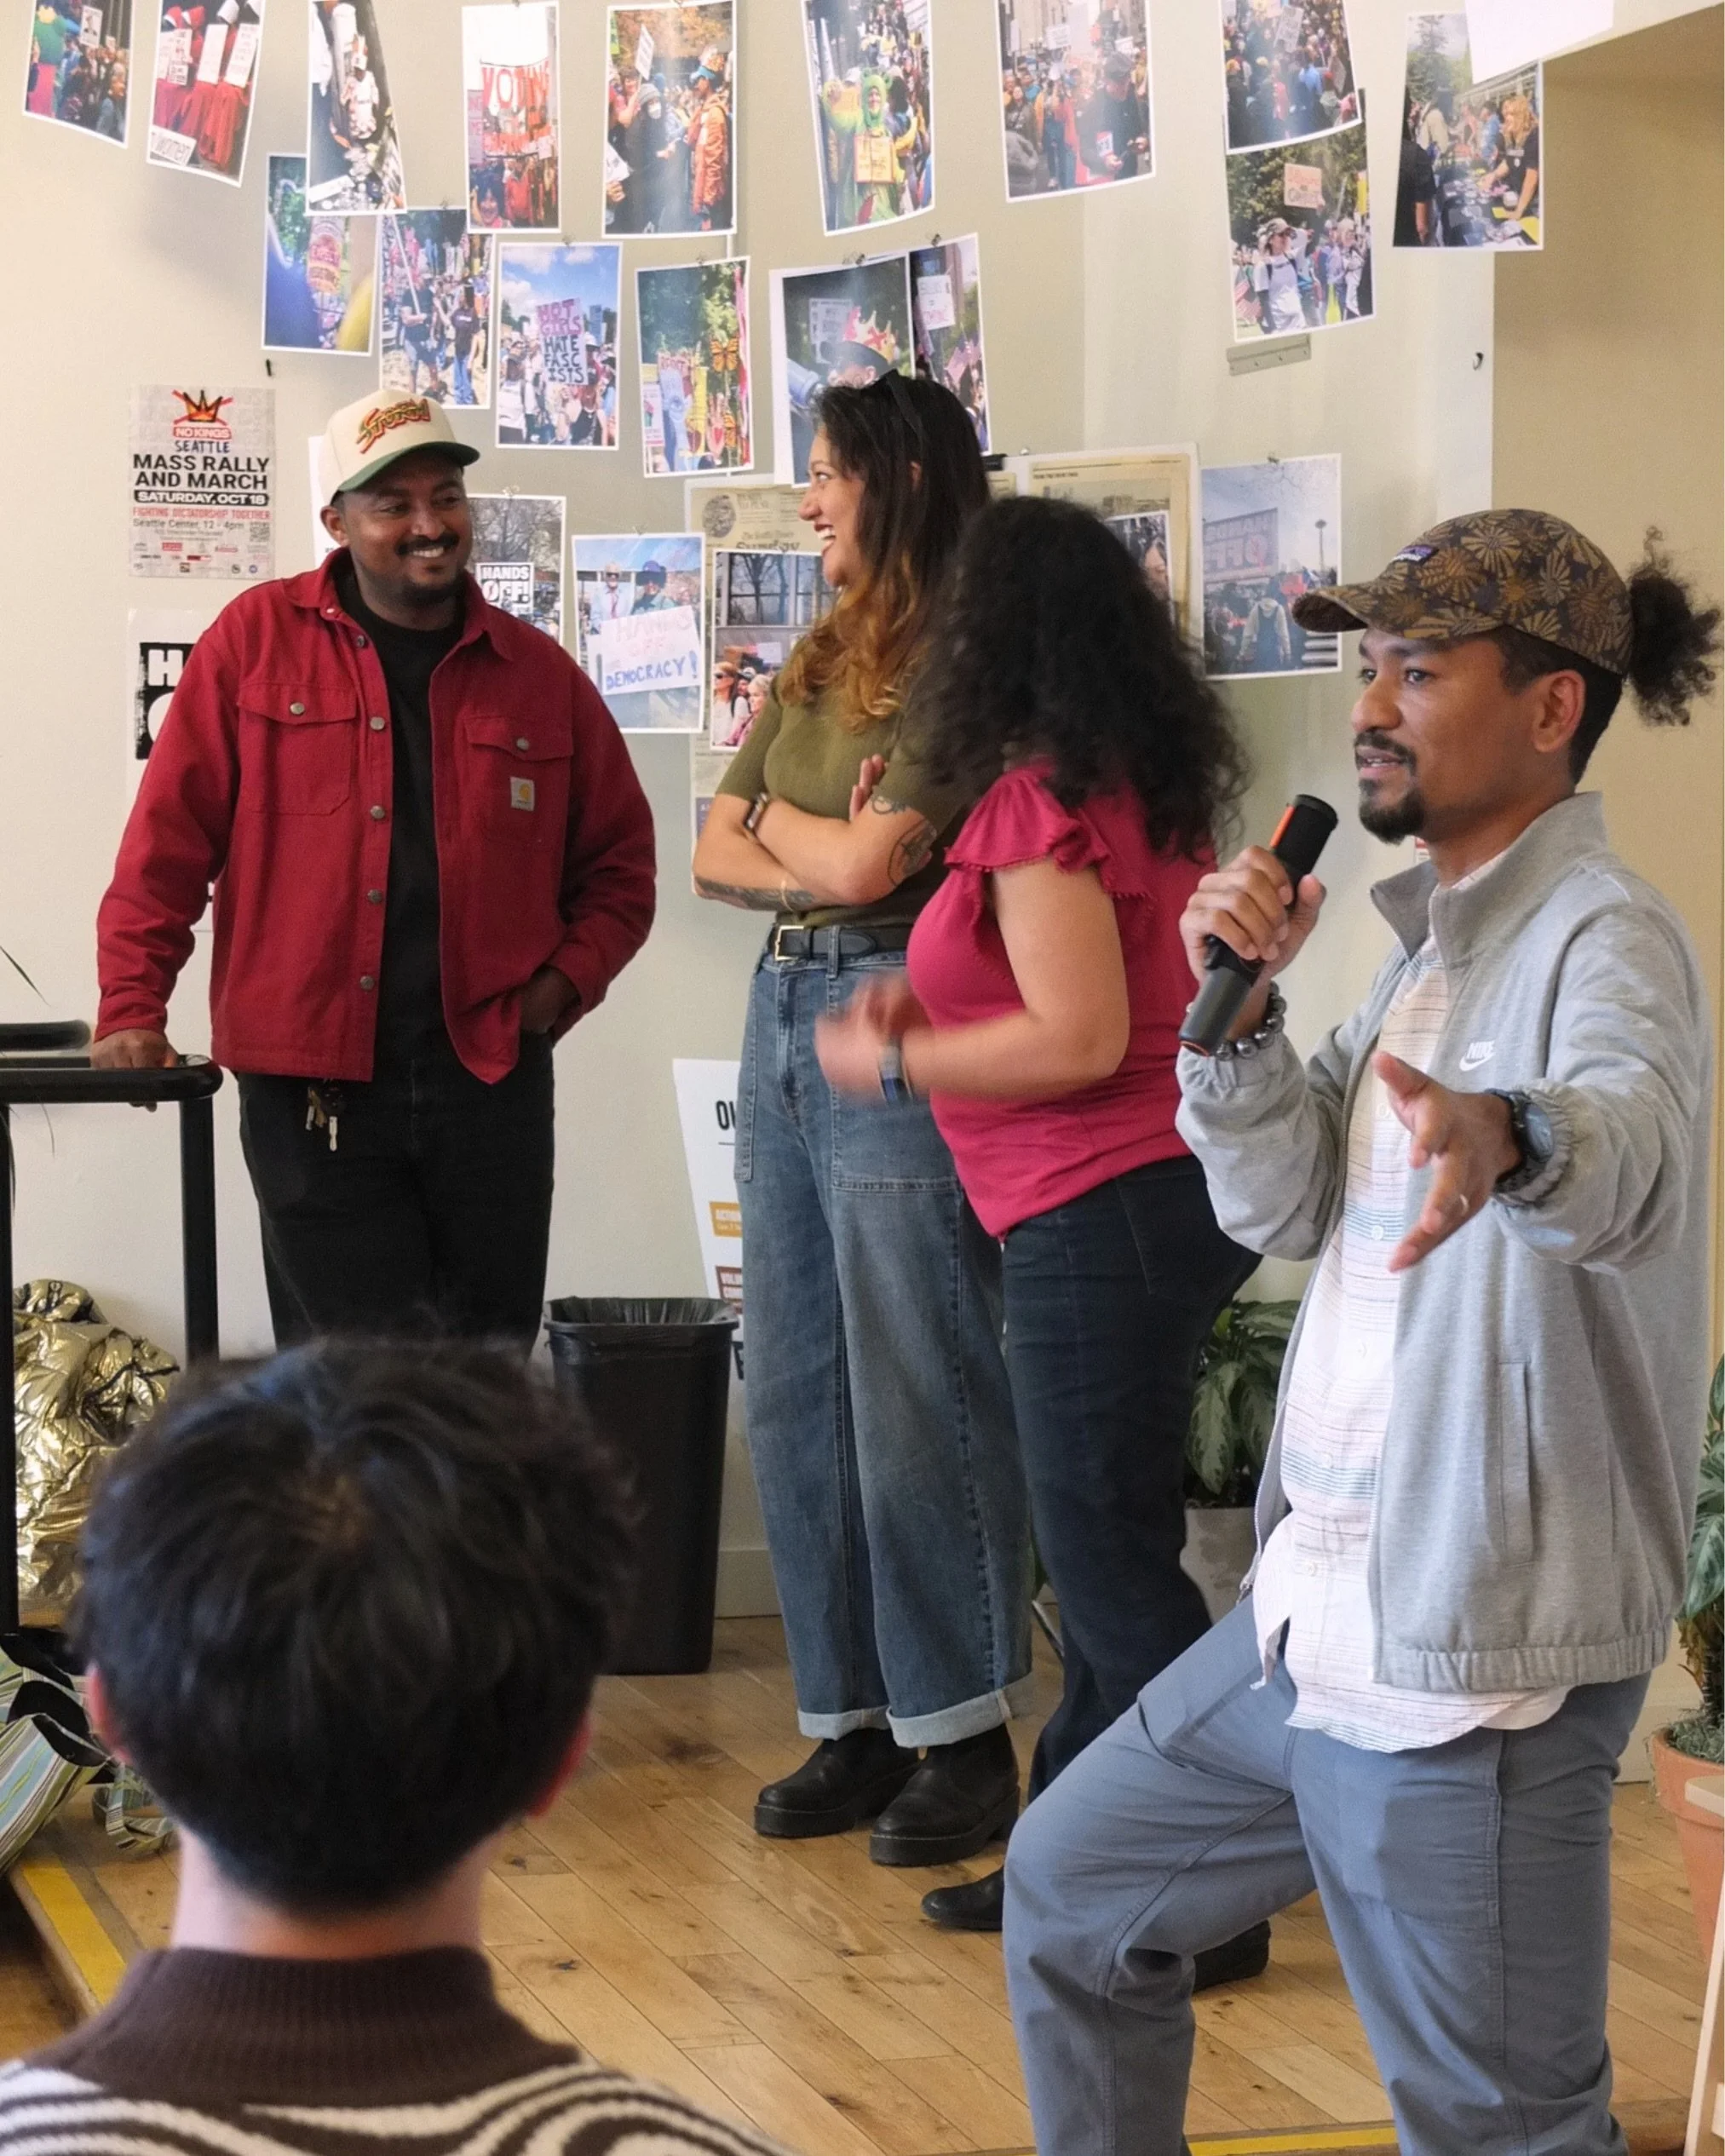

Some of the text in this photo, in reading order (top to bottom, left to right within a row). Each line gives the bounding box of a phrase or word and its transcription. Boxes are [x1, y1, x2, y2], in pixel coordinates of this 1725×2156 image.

[544, 334, 579, 353] HATE
[543, 353, 580, 367] FASC
[548, 367, 584, 383] ISTS
[175, 428, 230, 439] NO KINGS
[175, 440, 230, 453] SEATTLE
[133, 454, 270, 473] MASS RALLY
[135, 471, 267, 491] AND MARCH
[138, 492, 266, 505] SATURDAY, OCT 18
[133, 519, 165, 528] Seattle
[204, 520, 214, 529] 12
[224, 521, 244, 531] 4pm
[481, 566, 529, 580] HANDS
